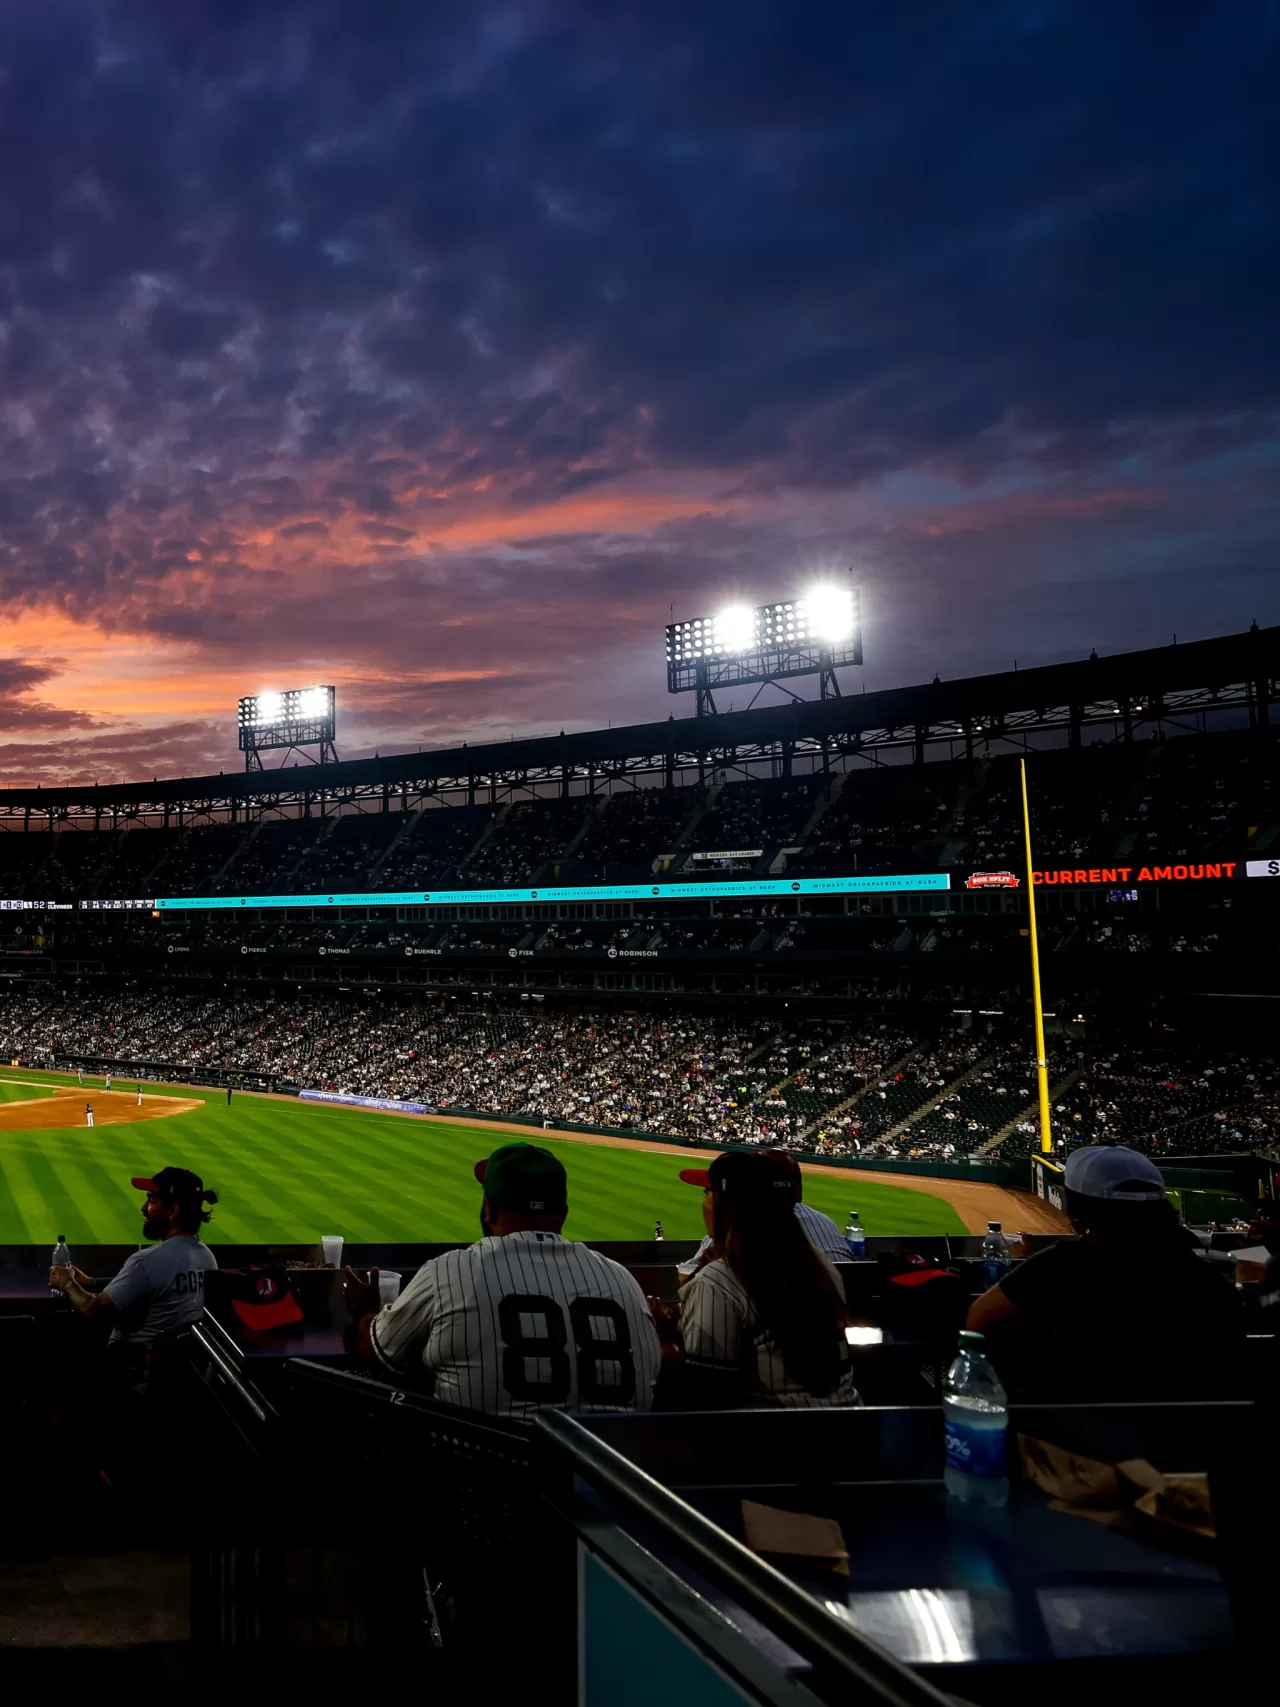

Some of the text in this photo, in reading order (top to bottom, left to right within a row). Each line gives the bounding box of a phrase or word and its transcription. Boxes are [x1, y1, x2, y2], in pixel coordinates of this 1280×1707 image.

[1032, 862, 1237, 886] CURRENT AMOUNT
[1268, 860, 1280, 875] $
[499, 1294, 636, 1404] 88
[389, 1391, 405, 1405] 12
